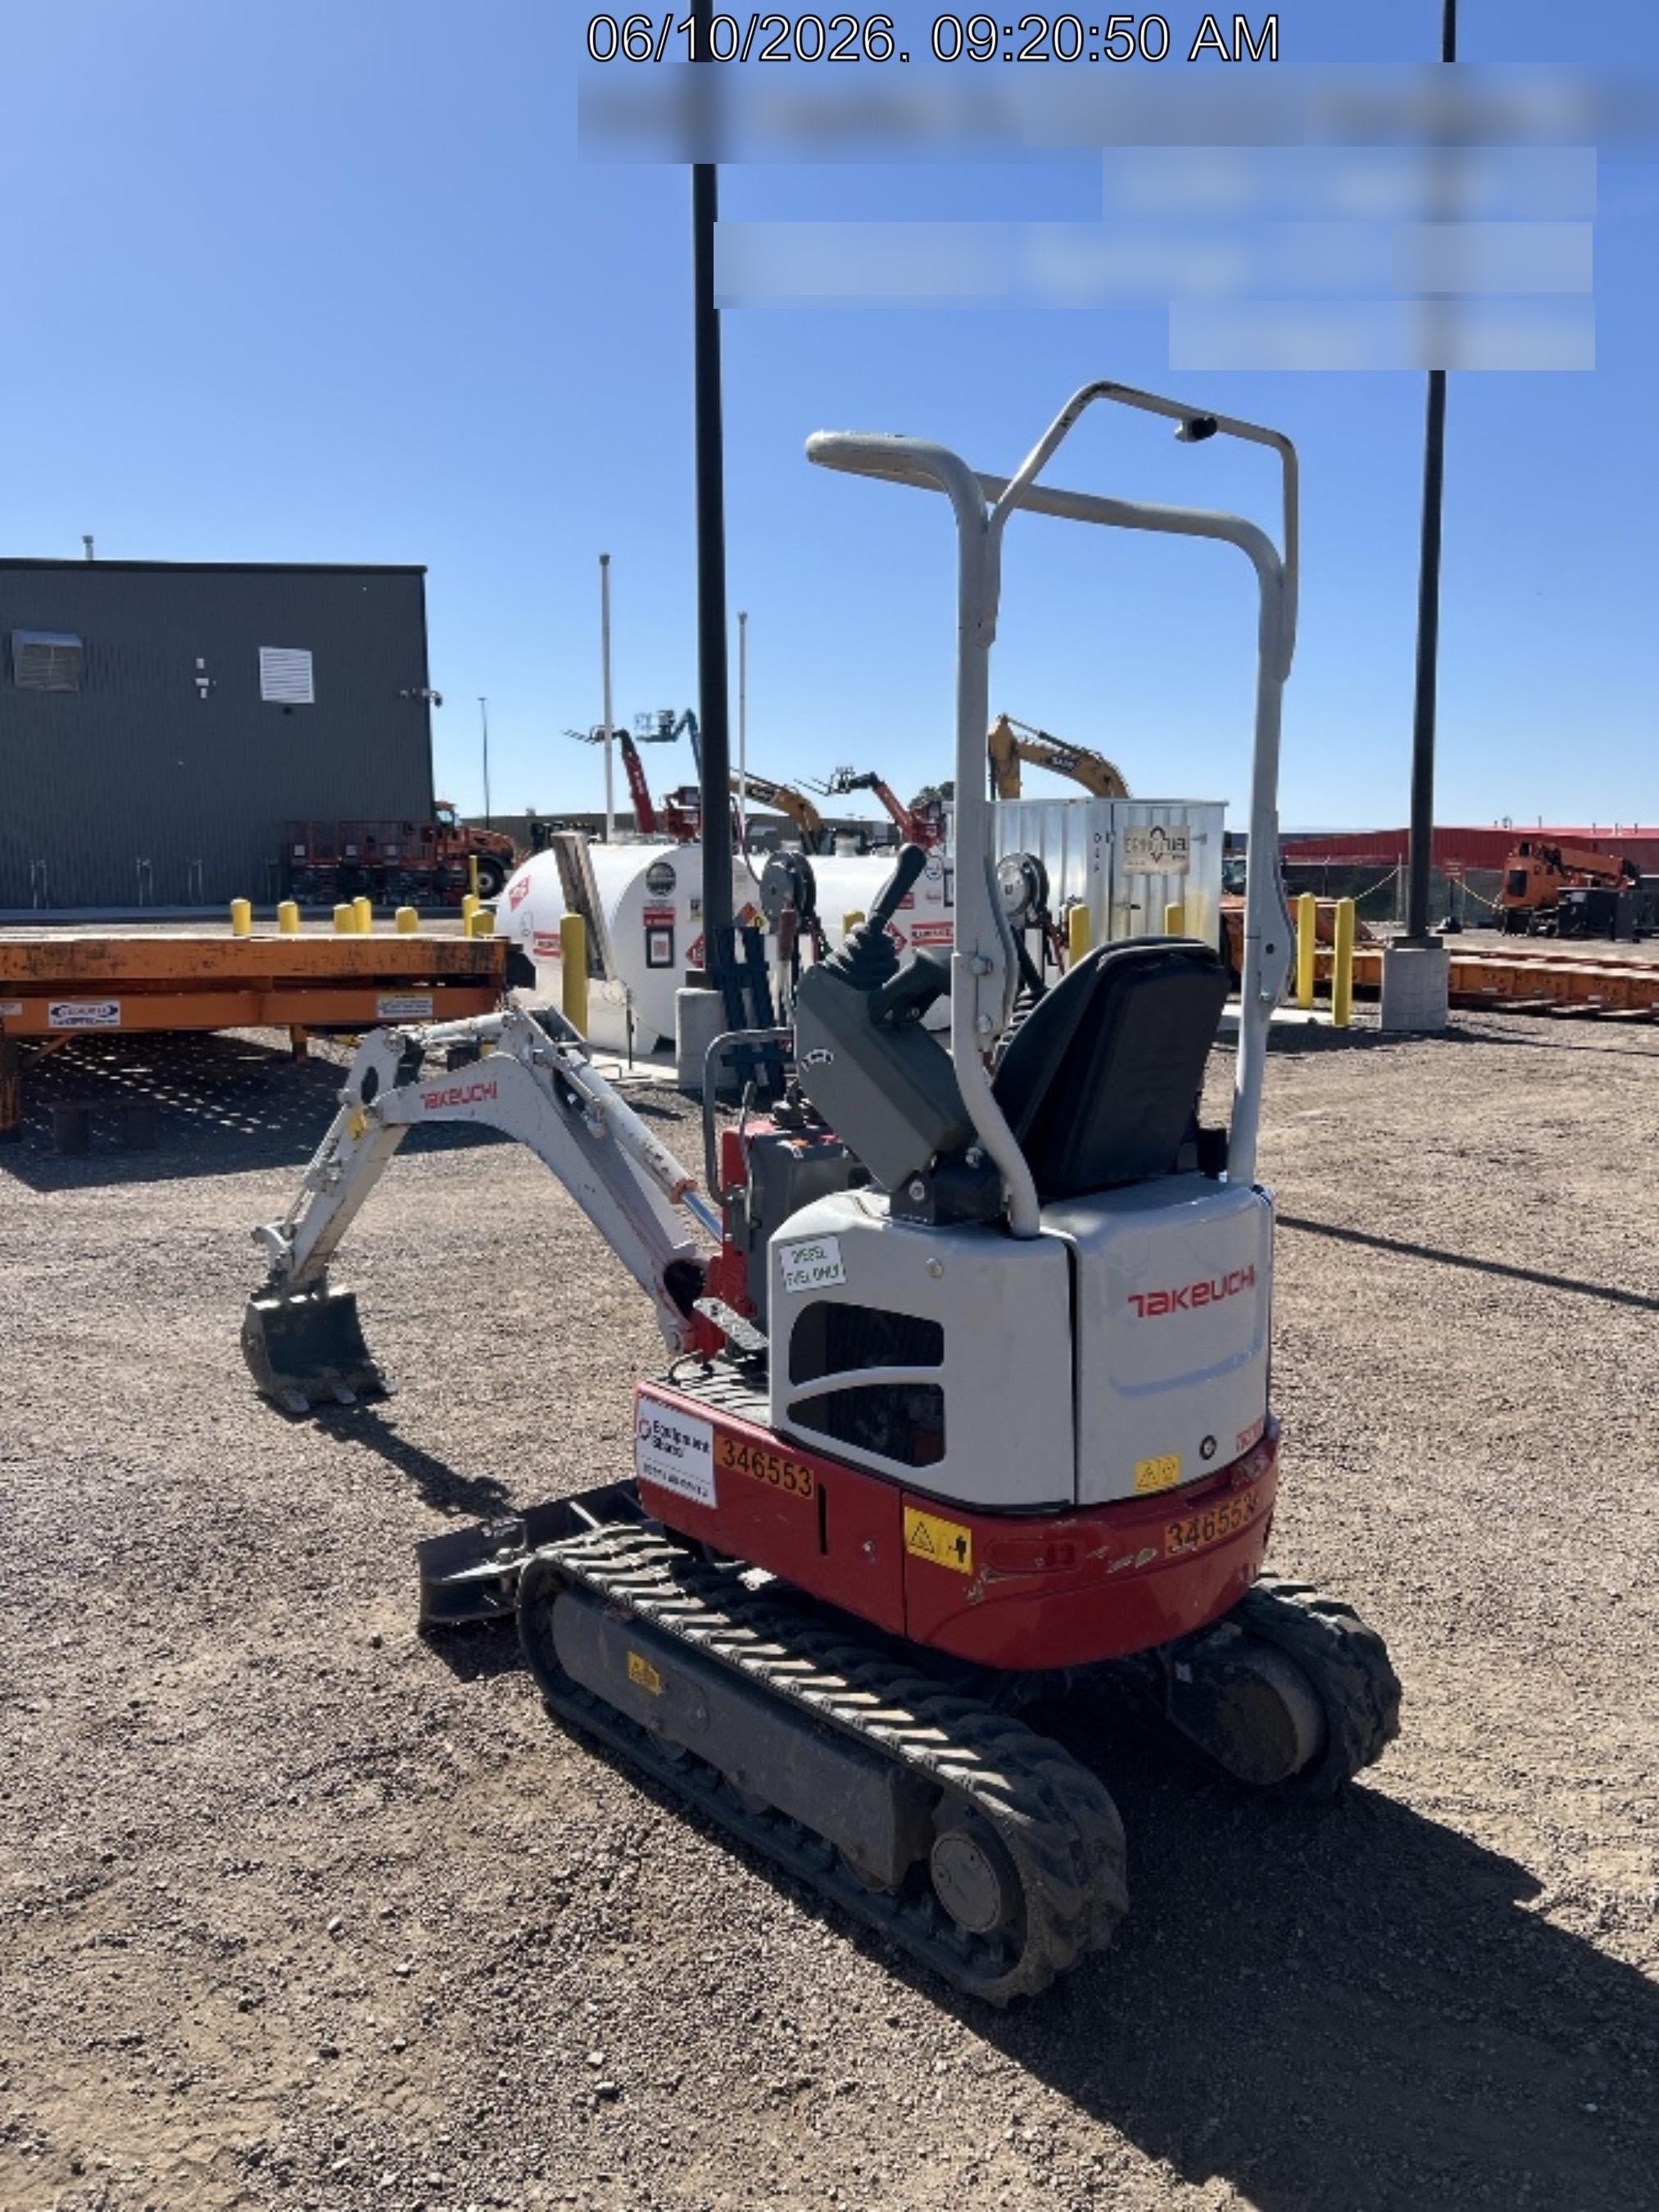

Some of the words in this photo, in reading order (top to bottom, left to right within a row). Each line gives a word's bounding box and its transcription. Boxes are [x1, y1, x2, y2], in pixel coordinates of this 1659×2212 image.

[813, 1262, 839, 1281] ONLY
[1127, 1263, 1255, 1318] TAKEUCHI
[722, 1439, 813, 1498] 346553
